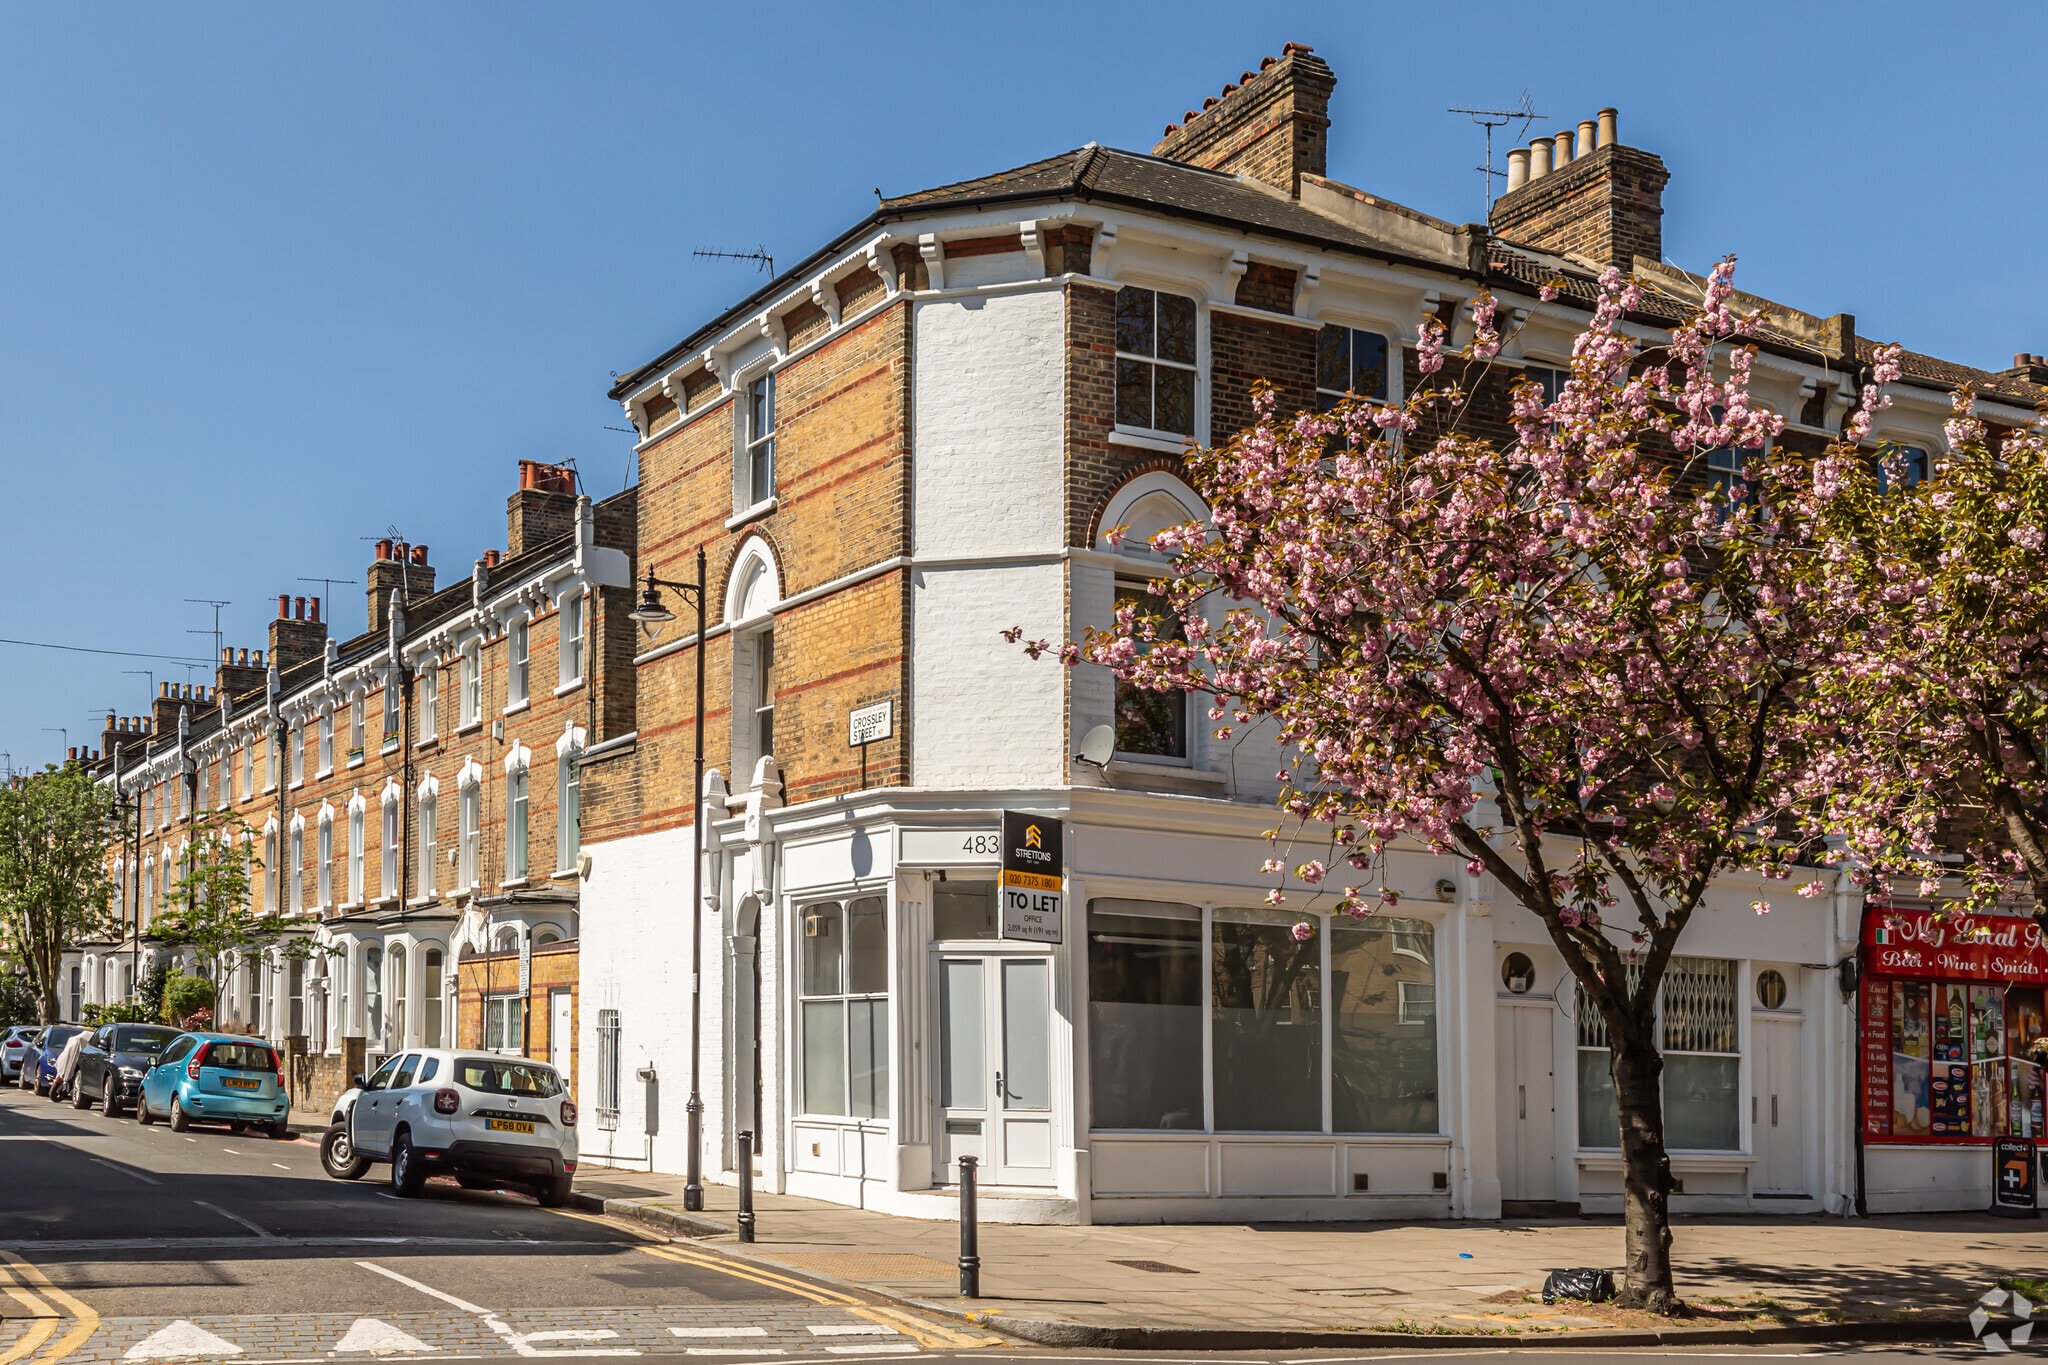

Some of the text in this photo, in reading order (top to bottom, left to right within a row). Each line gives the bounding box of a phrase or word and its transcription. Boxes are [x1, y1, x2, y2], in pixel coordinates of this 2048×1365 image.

[853, 711, 887, 729] CROSSLEY
[853, 726, 876, 741] STREET
[962, 835, 999, 854] 483
[1015, 848, 1051, 862] STRETTONS
[1009, 874, 1055, 888] 020 7375 1801
[1008, 891, 1059, 912] TO LET
[1024, 914, 1042, 923] OFFICE
[1022, 927, 1027, 935] sq
[1900, 915, 1945, 948] My
[1954, 918, 2017, 947] Local
[1882, 950, 2039, 976] Beer Wine Spirits
[486, 1111, 536, 1119] DUSTER
[491, 1120, 533, 1132] LP68 OVA
